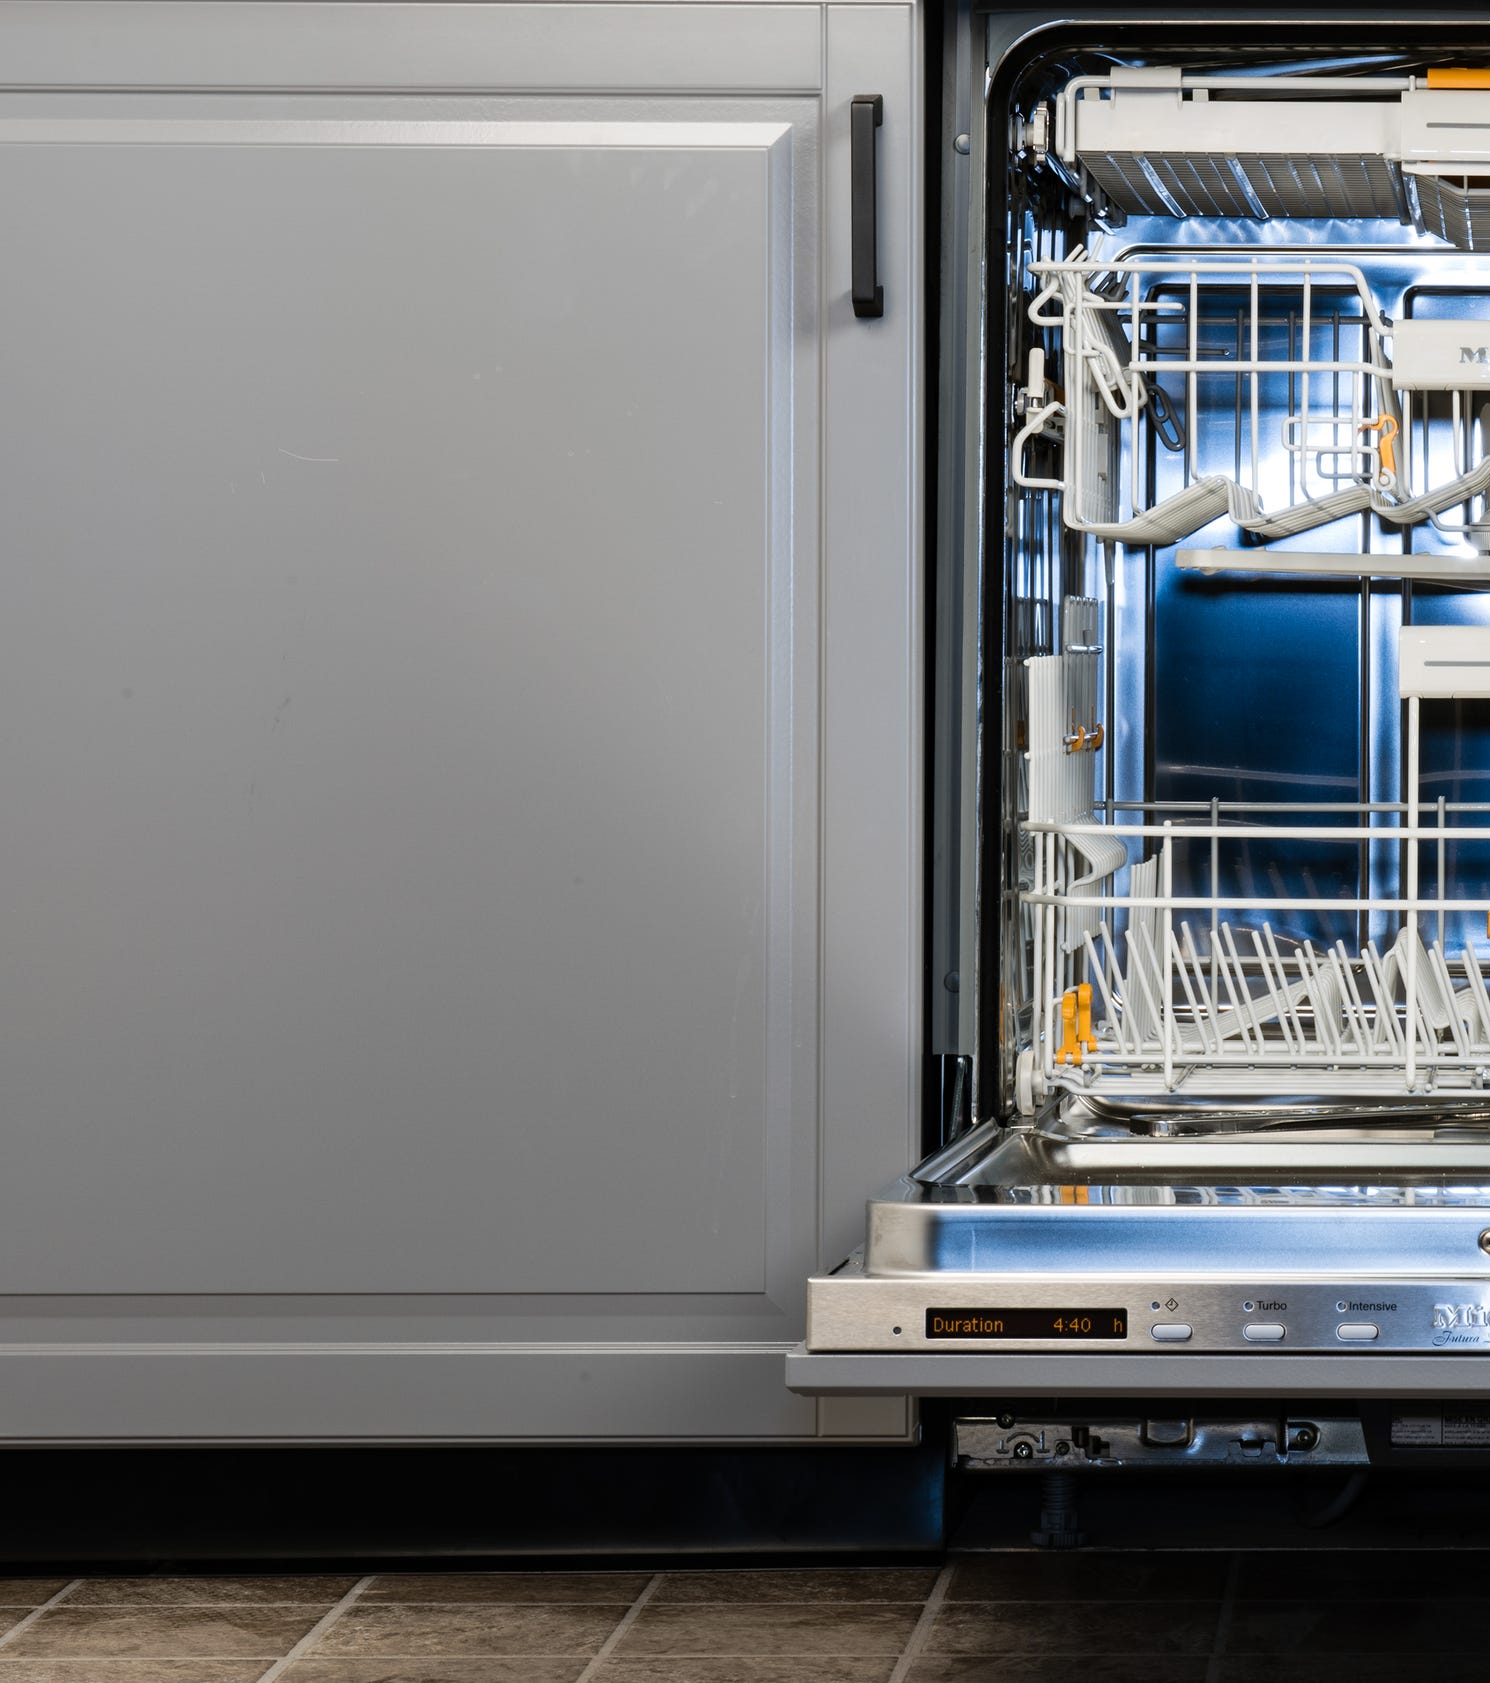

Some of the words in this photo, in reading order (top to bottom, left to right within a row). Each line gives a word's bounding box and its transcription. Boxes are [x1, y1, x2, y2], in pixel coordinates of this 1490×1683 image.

[1257, 1301, 1288, 1311] Turbo
[1349, 1301, 1398, 1312] Intensive
[932, 1317, 1004, 1333] Duration
[1052, 1317, 1092, 1333] 4:40
[1113, 1317, 1123, 1333] h
[1431, 1330, 1480, 1347] Futura
